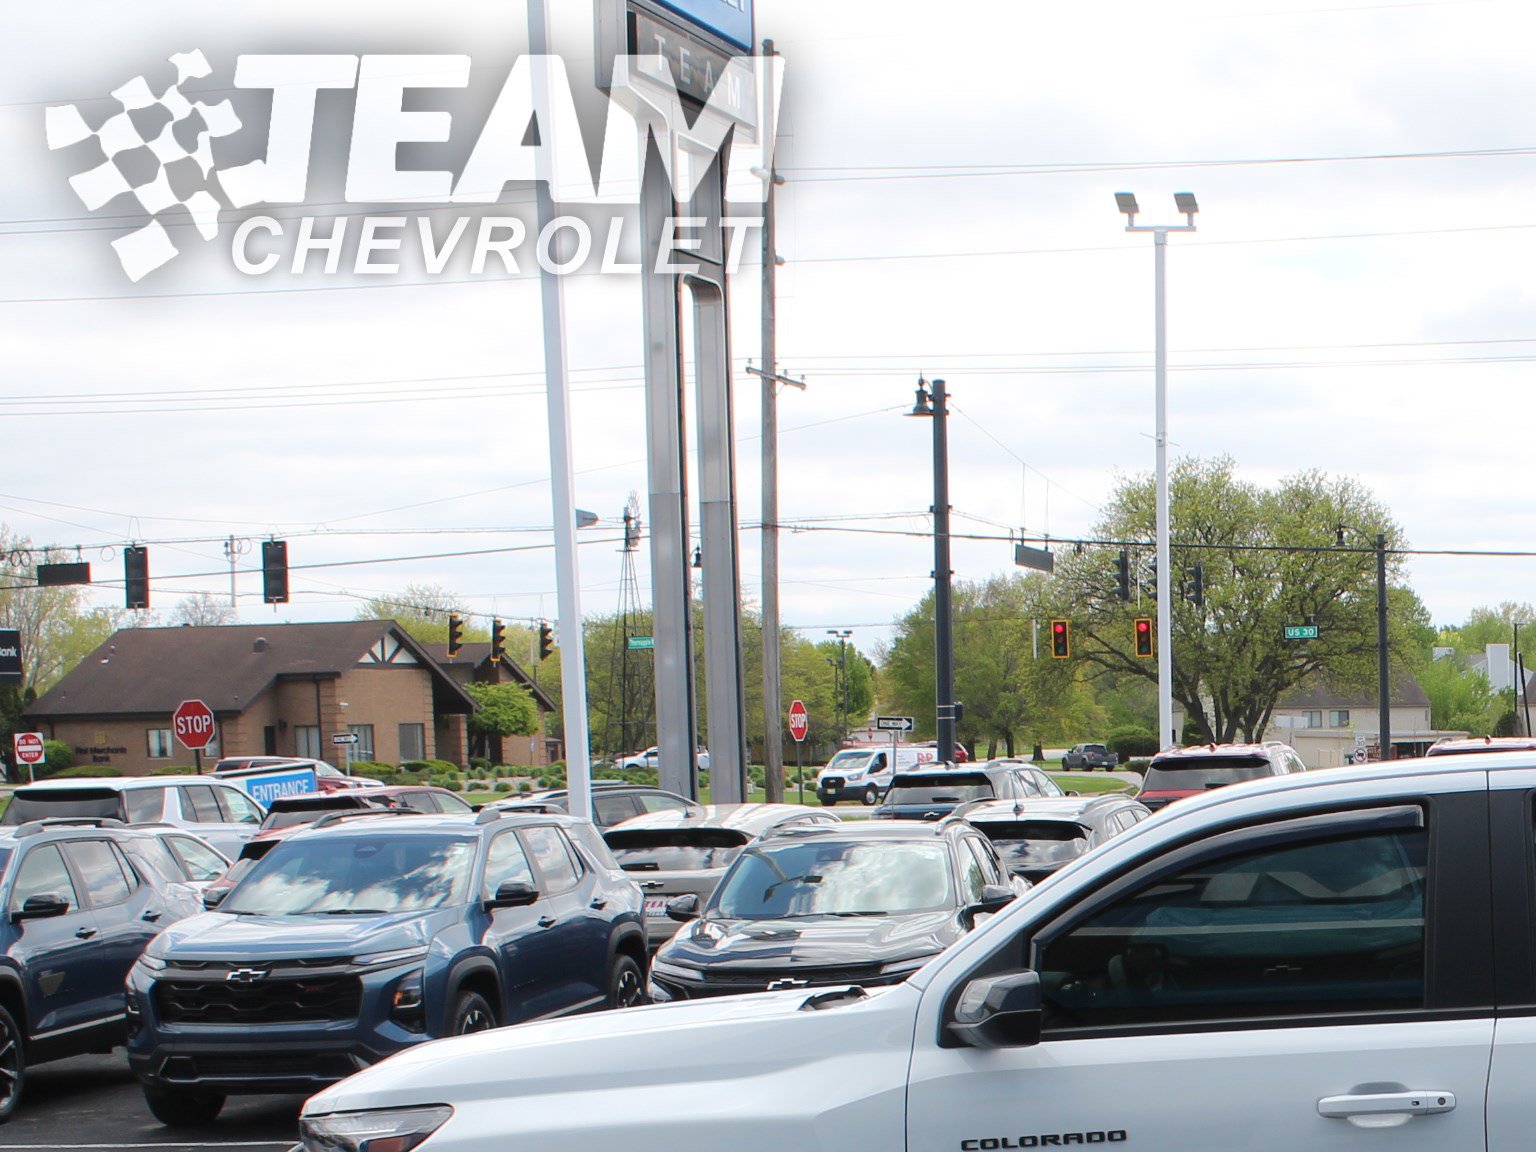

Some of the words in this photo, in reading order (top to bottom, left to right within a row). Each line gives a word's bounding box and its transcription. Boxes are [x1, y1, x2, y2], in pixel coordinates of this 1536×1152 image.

[654, 34, 741, 109] TEAM
[1288, 628, 1300, 636] US
[1303, 627, 1314, 636] 30
[177, 714, 211, 735] STOP
[790, 713, 807, 729] STOP
[252, 779, 309, 802] ENTRANCE
[645, 900, 667, 908] TEA
[961, 1130, 1127, 1151] COLORADO
